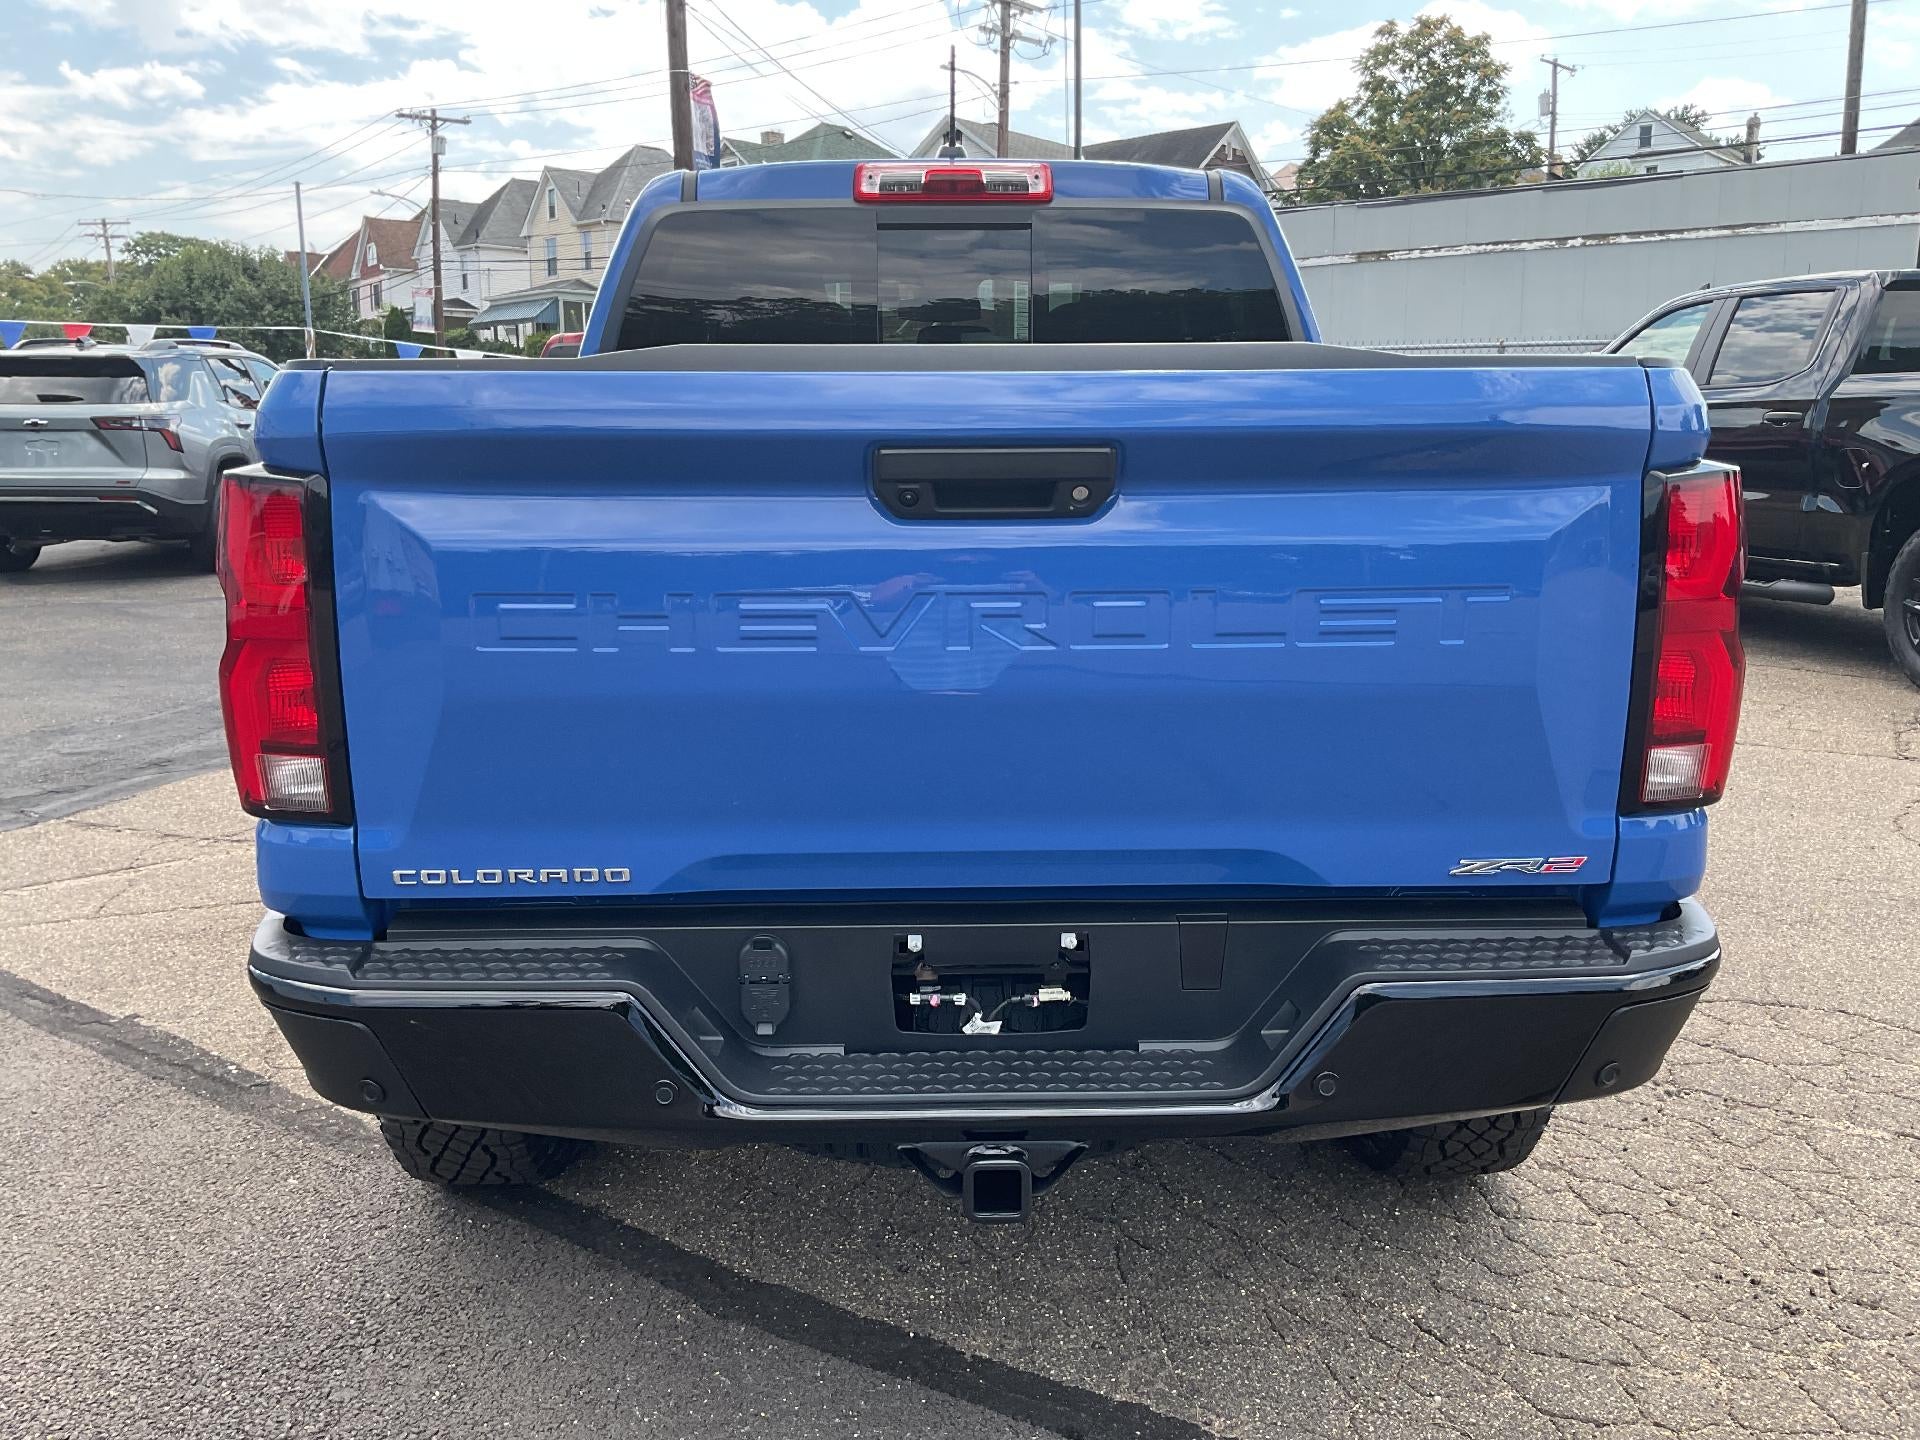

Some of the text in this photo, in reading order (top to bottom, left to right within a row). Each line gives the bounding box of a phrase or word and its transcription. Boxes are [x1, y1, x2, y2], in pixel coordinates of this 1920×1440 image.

[471, 585, 1513, 653] CHEVROLET
[1448, 856, 1588, 875] ZR2
[391, 867, 632, 886] COLORADO
